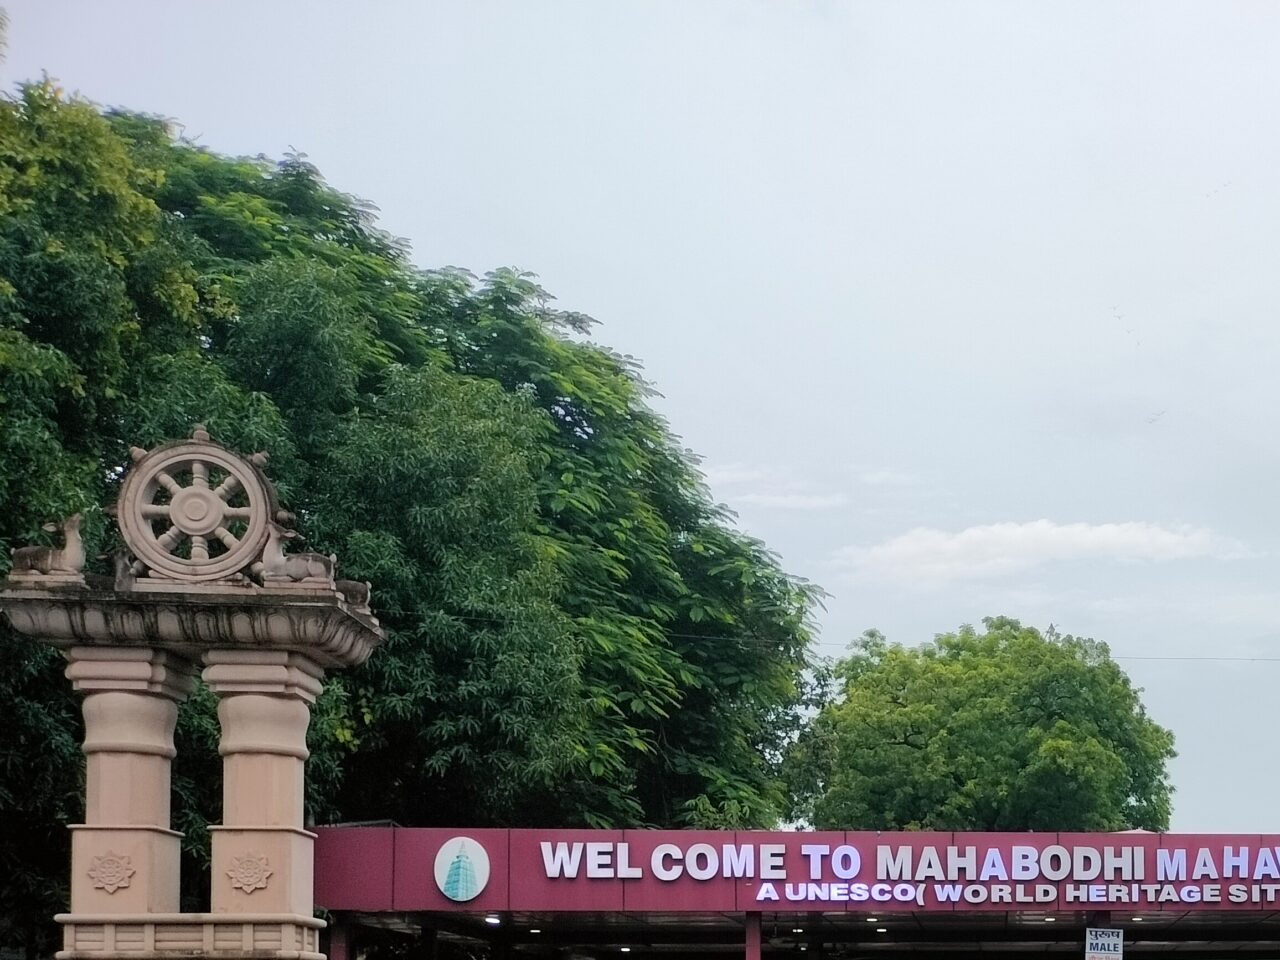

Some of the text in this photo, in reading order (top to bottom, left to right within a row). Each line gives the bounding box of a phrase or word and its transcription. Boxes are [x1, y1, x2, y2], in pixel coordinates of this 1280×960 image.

[801, 844, 861, 880] TO
[876, 845, 1145, 881] MAHABODHI
[756, 883, 780, 901] A
[934, 884, 1058, 903] WORLD
[1065, 884, 1221, 903] HERITAGE
[1089, 942, 1119, 952] MALE
